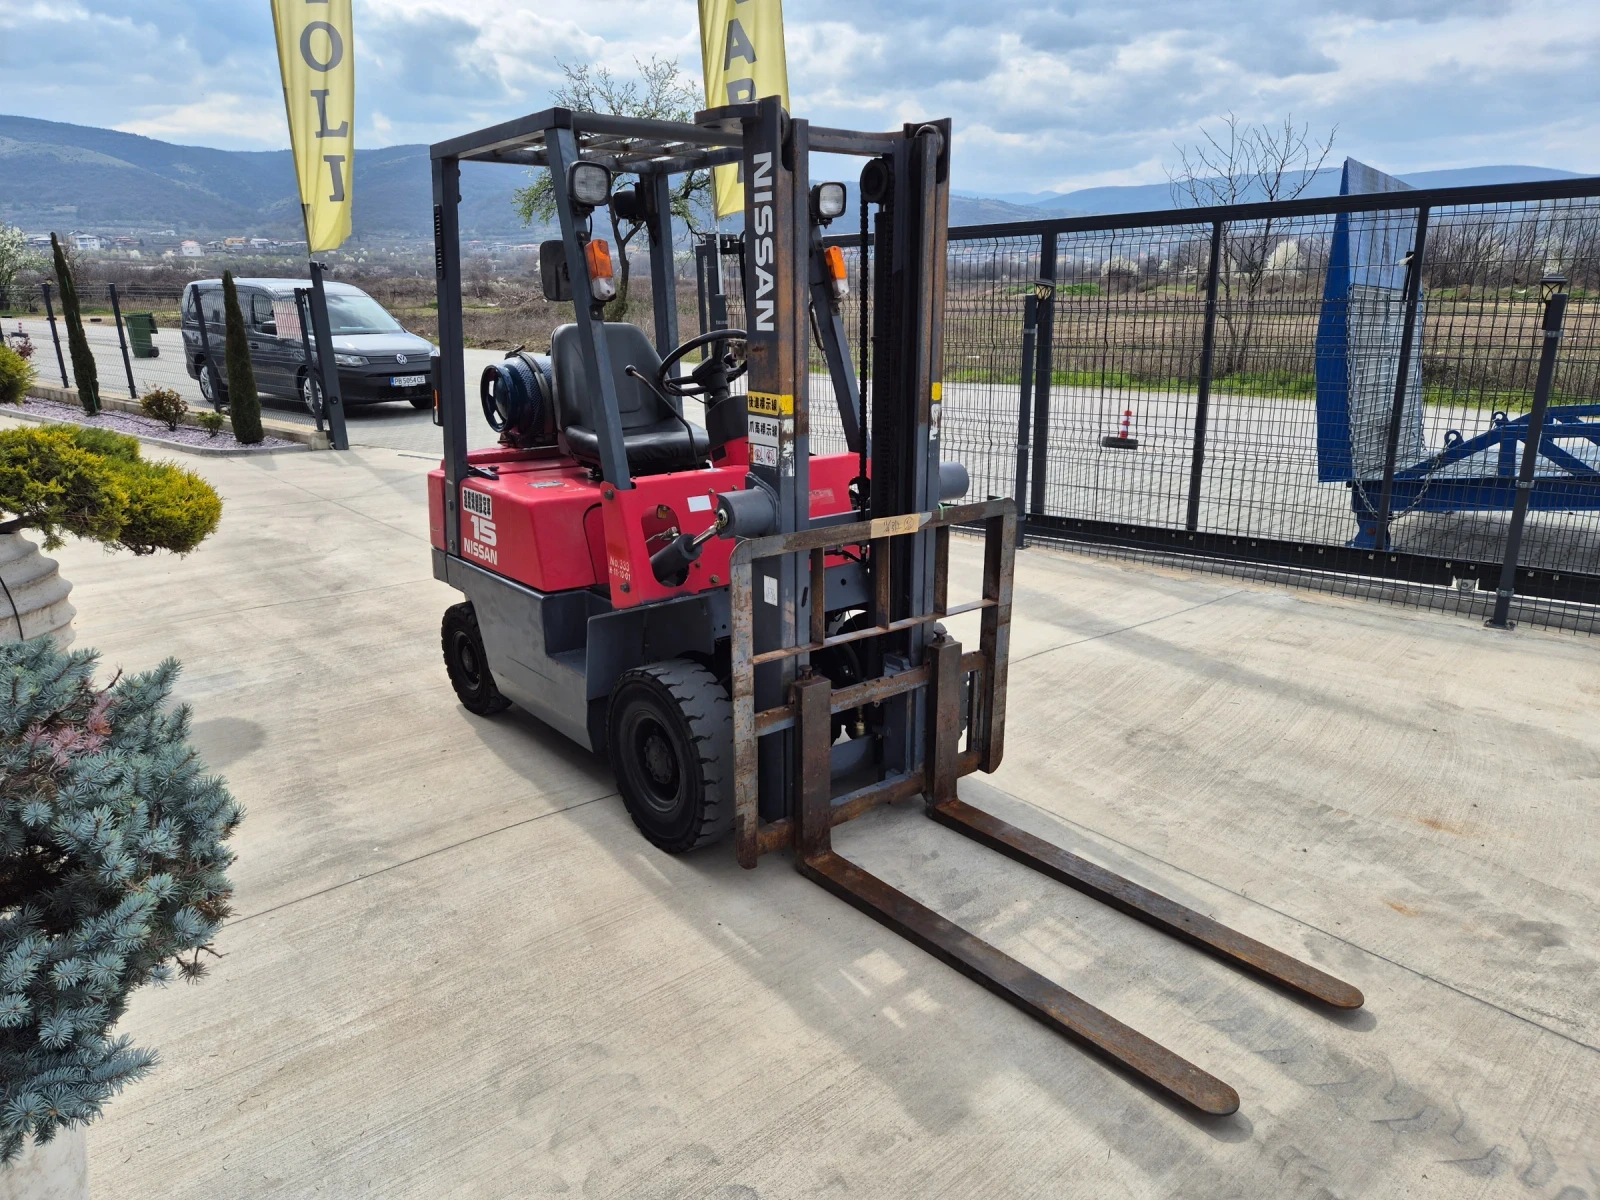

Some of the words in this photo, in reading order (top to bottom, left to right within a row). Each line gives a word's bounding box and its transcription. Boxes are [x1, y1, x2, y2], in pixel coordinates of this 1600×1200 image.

[300, 0, 349, 202] OLI
[753, 152, 775, 332] NISSAN
[463, 537, 498, 566] NISSAN
[470, 515, 497, 547] 15
